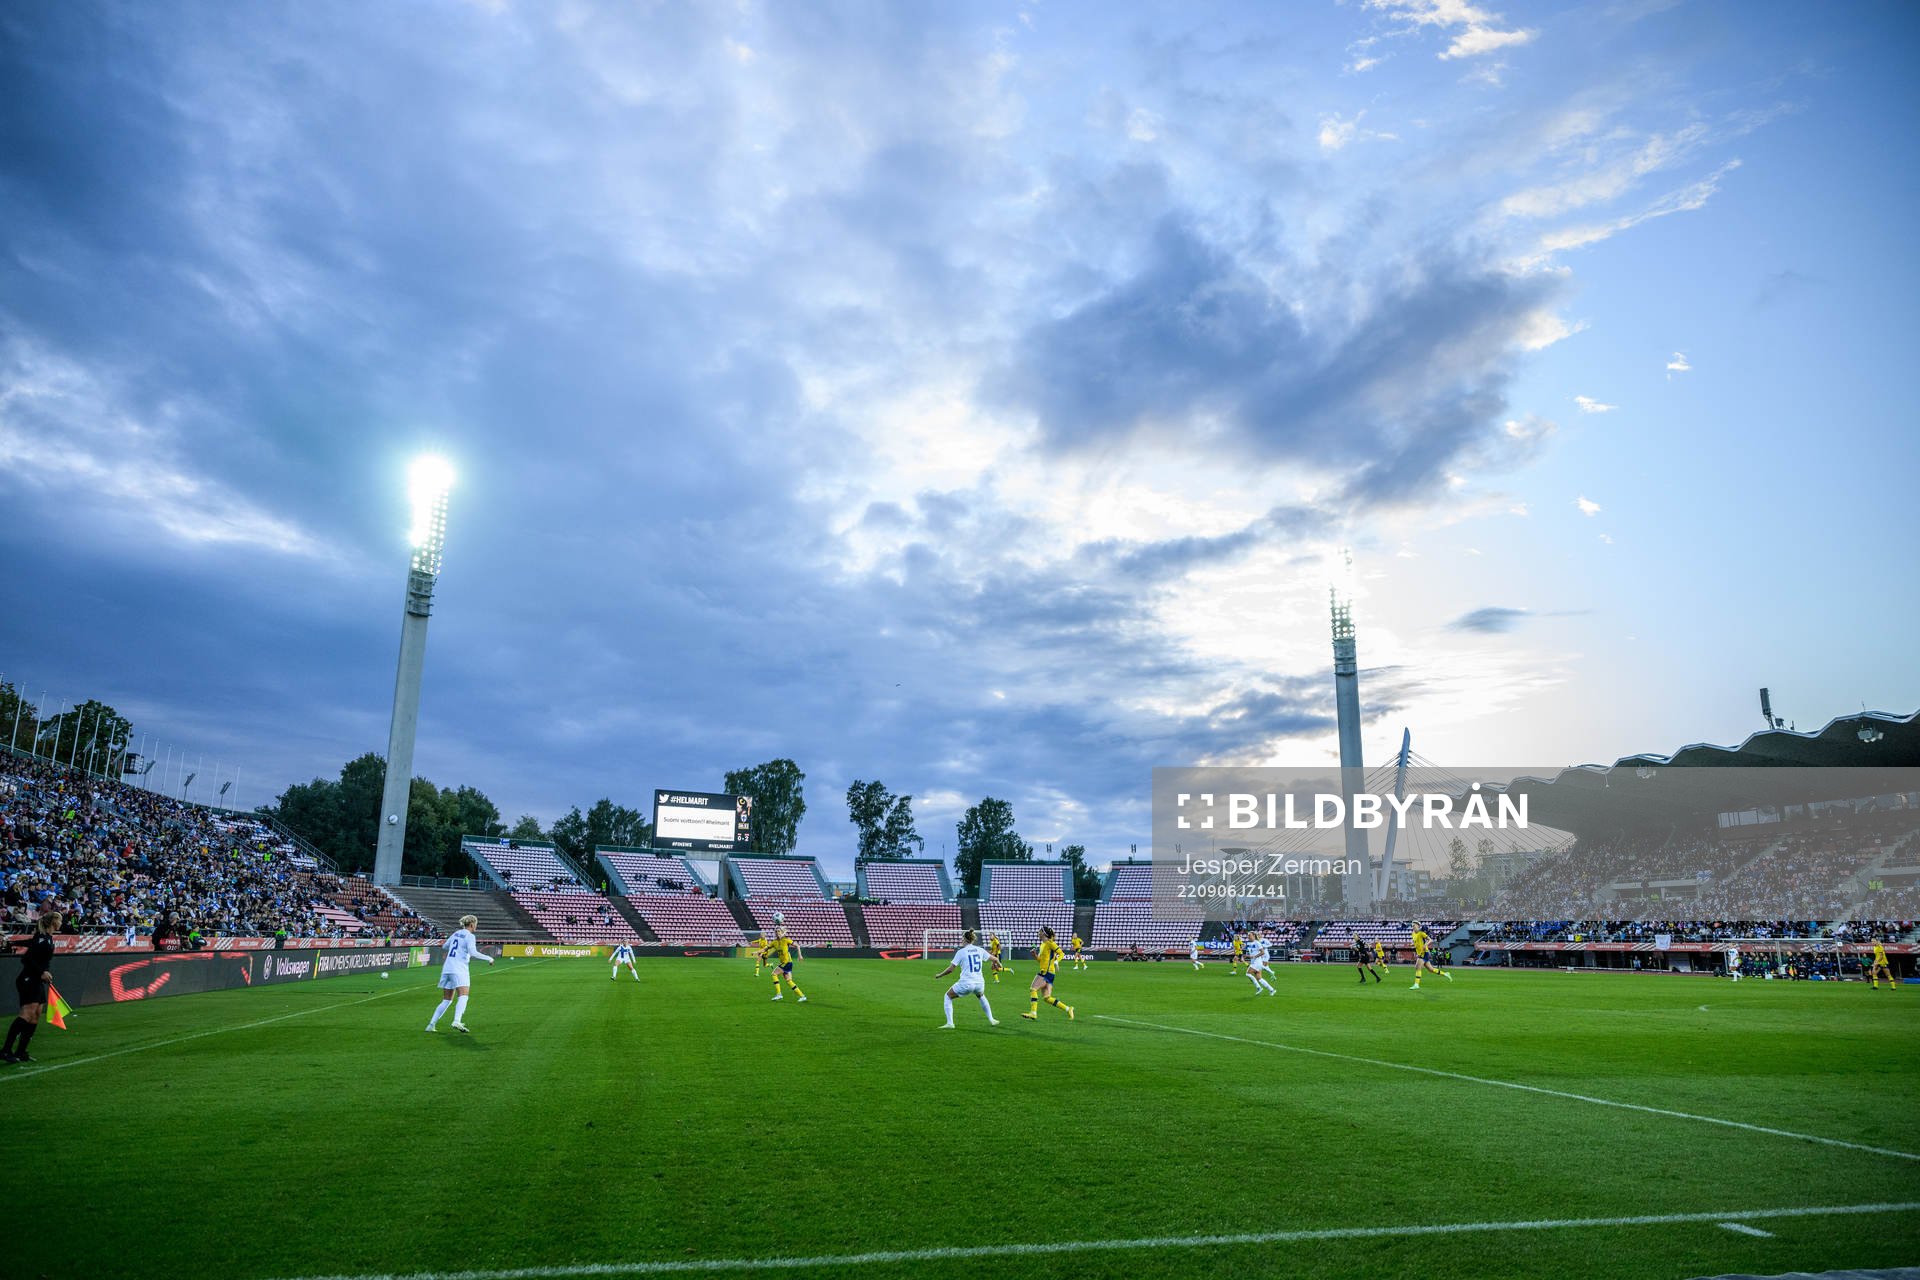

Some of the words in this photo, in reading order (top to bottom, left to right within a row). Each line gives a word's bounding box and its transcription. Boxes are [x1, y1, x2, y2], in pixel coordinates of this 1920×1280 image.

[671, 796, 708, 805] #HELMARIT
[448, 938, 459, 958] 2
[541, 947, 591, 957] Volkswagen
[276, 957, 310, 978] Volkswagen
[967, 954, 981, 973] 15
